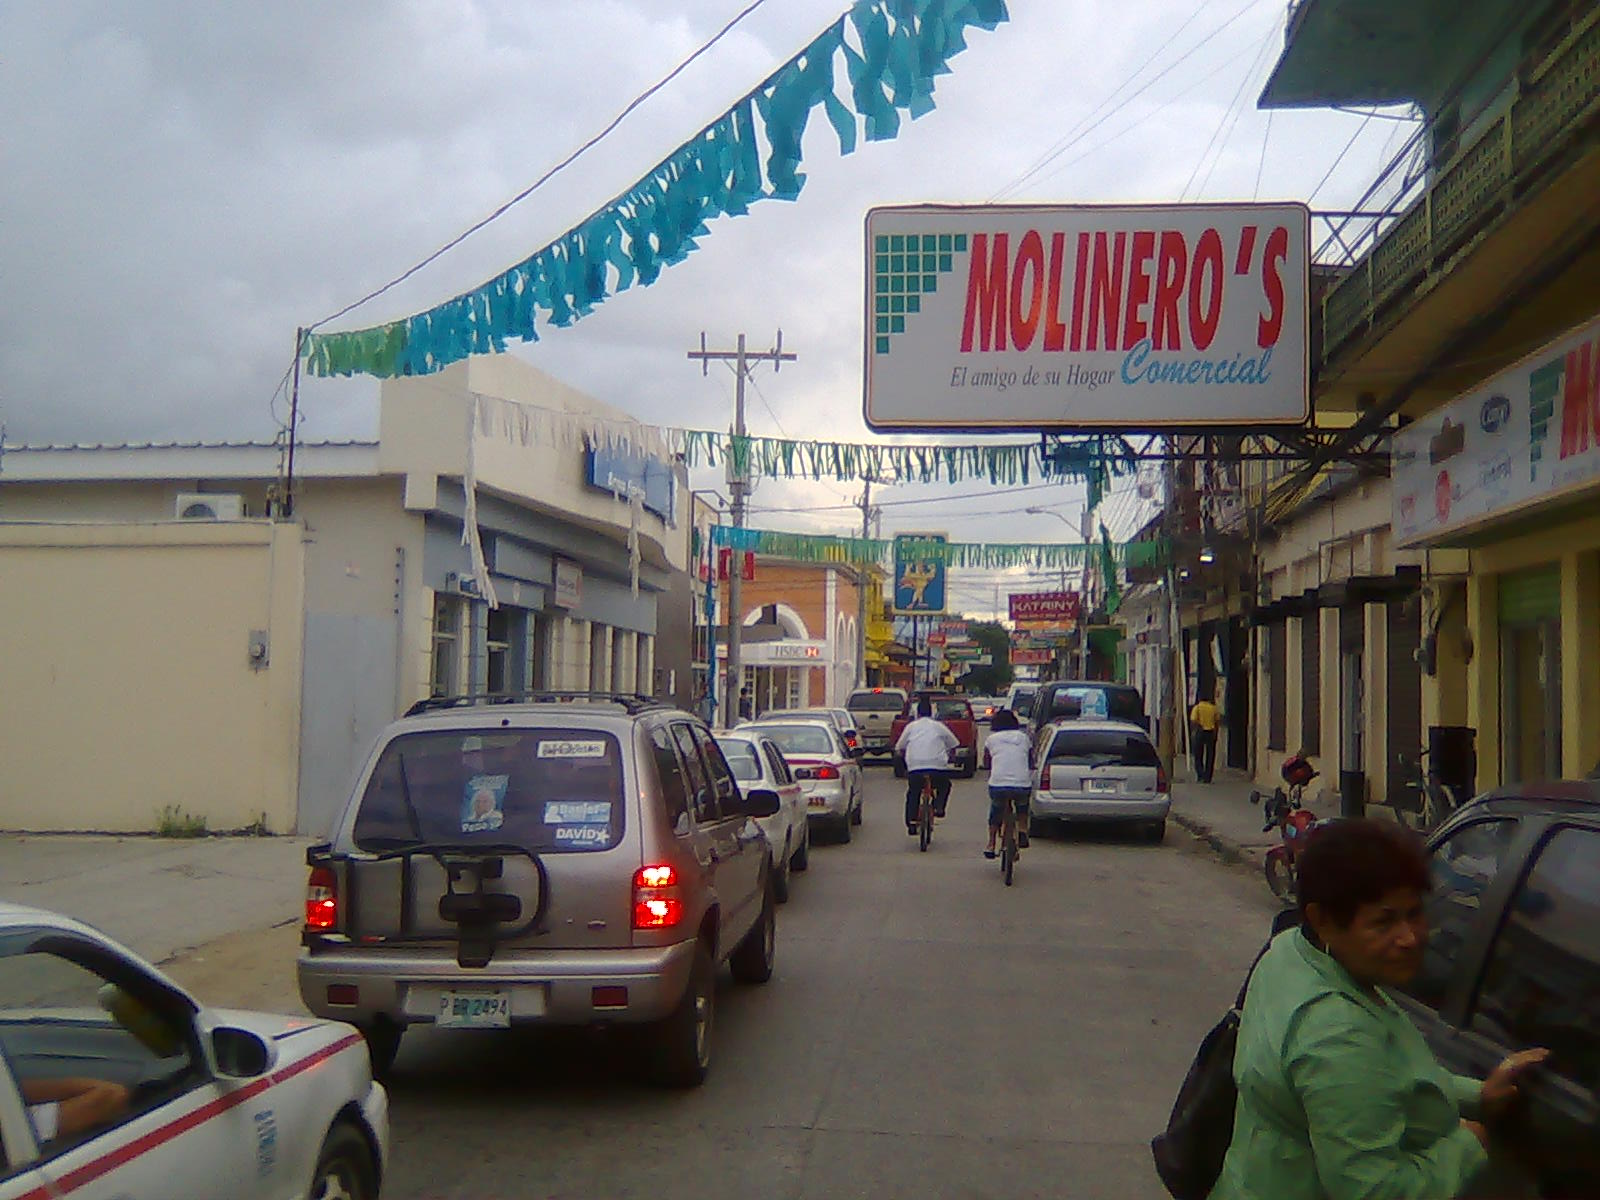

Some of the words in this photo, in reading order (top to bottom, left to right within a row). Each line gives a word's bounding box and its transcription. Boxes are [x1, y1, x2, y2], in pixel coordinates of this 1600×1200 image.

[960, 226, 1288, 352] MOLINERO'S
[950, 366, 968, 388] El
[970, 366, 1017, 390] amigo
[1021, 364, 1040, 387] de
[1043, 368, 1060, 387] su
[1067, 366, 1116, 391] Hogar
[1120, 339, 1273, 385] Comercial
